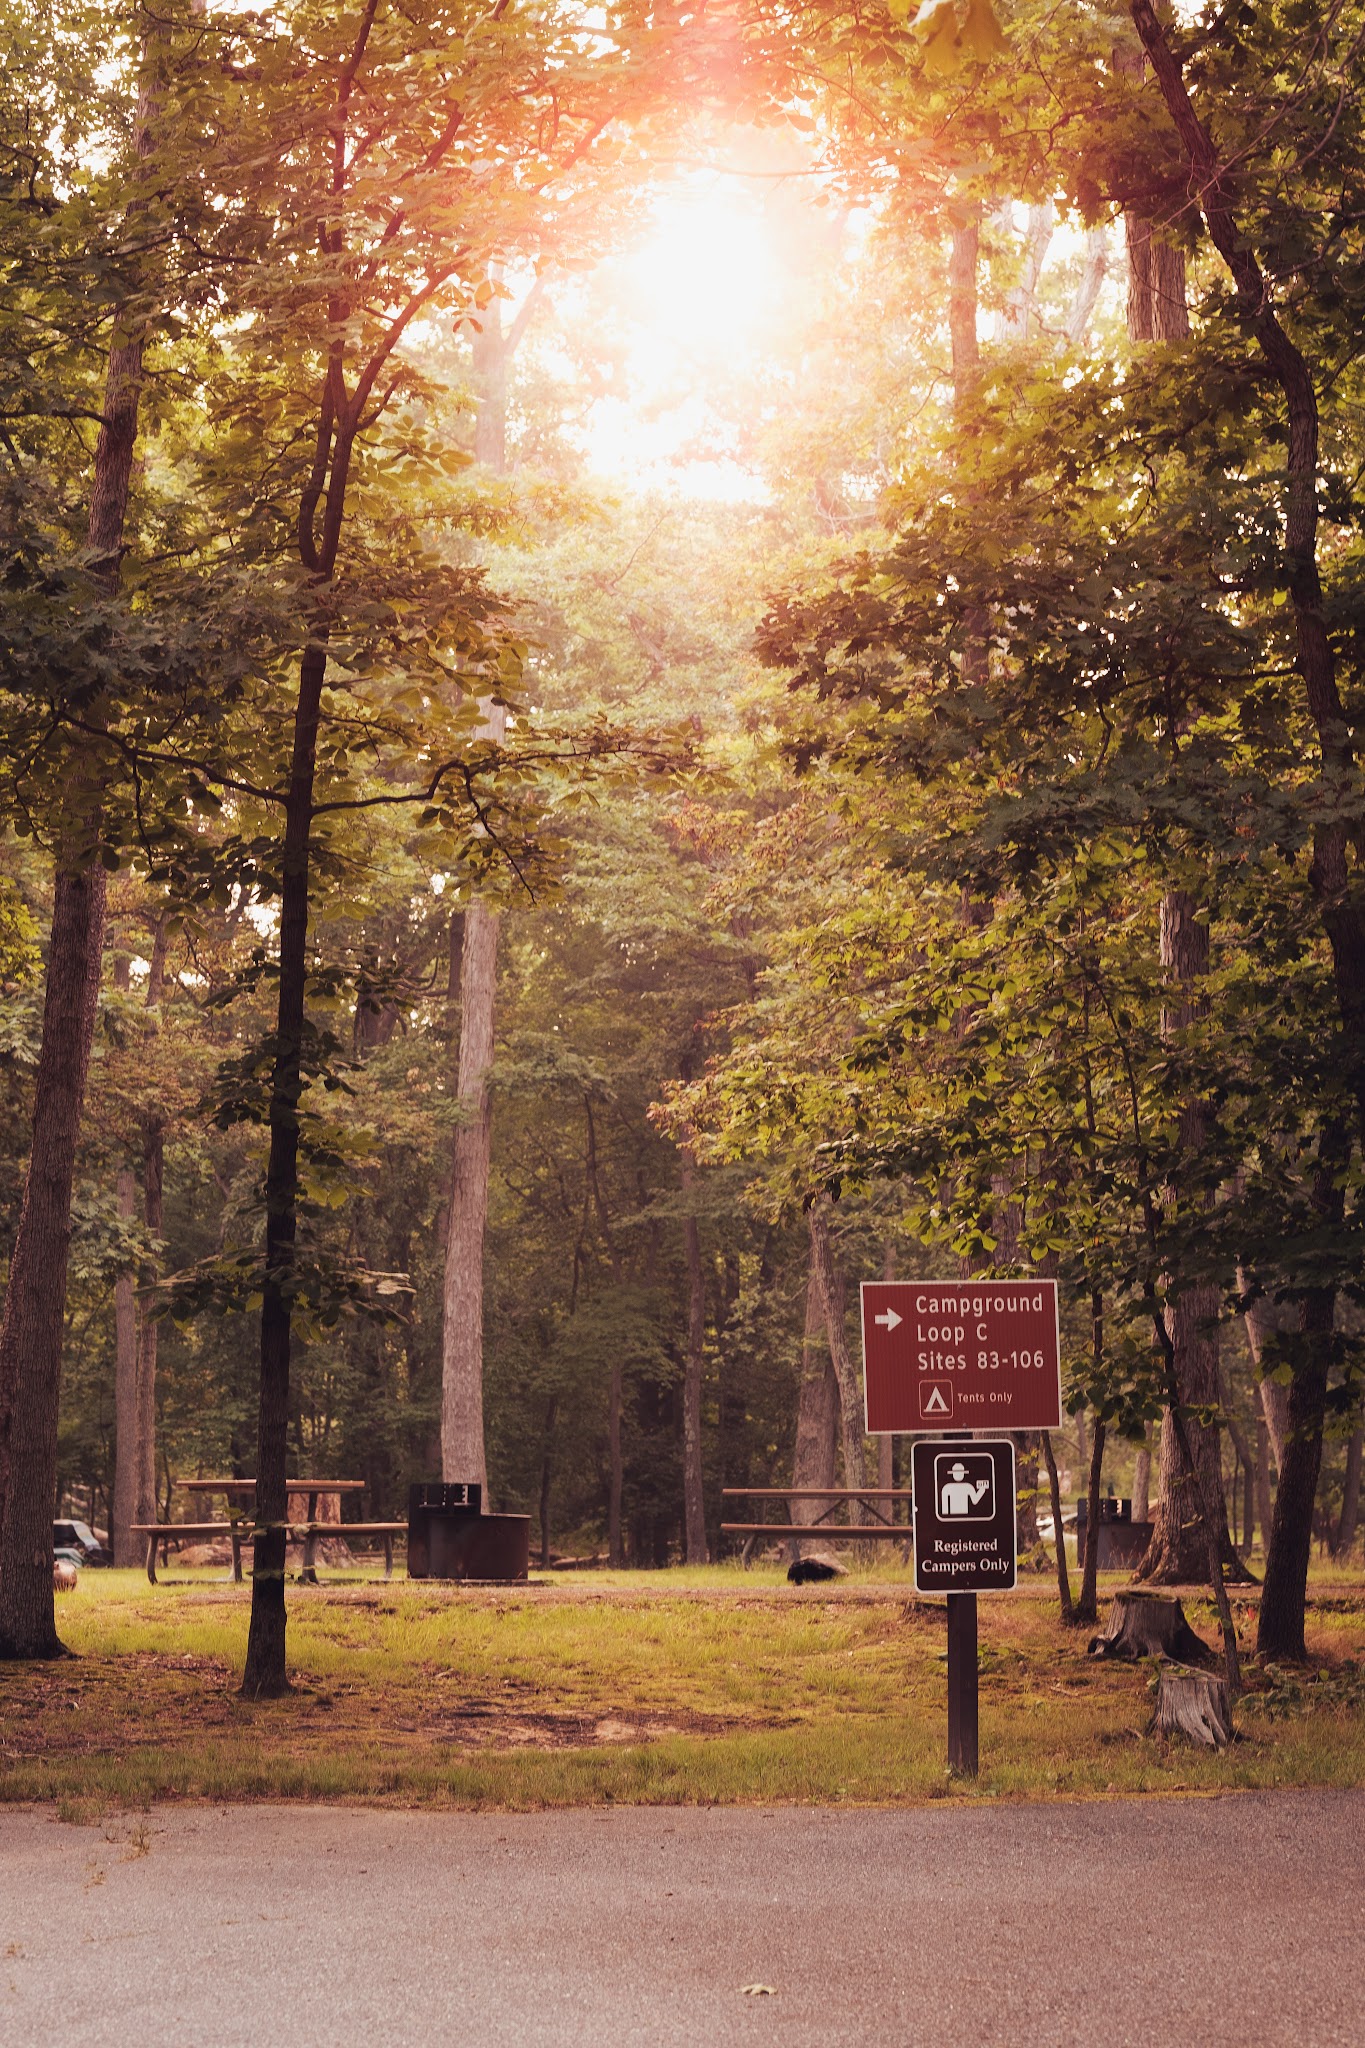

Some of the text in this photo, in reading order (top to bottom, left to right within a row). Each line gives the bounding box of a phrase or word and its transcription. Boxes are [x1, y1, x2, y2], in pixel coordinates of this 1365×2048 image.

[916, 1293, 1043, 1317] Campground
[917, 1323, 988, 1346] Loop C
[918, 1350, 1044, 1370] Sites 83-106
[957, 1392, 1012, 1404] Tents Only
[934, 1538, 997, 1555] Registered
[921, 1558, 1009, 1575] Campers Only
